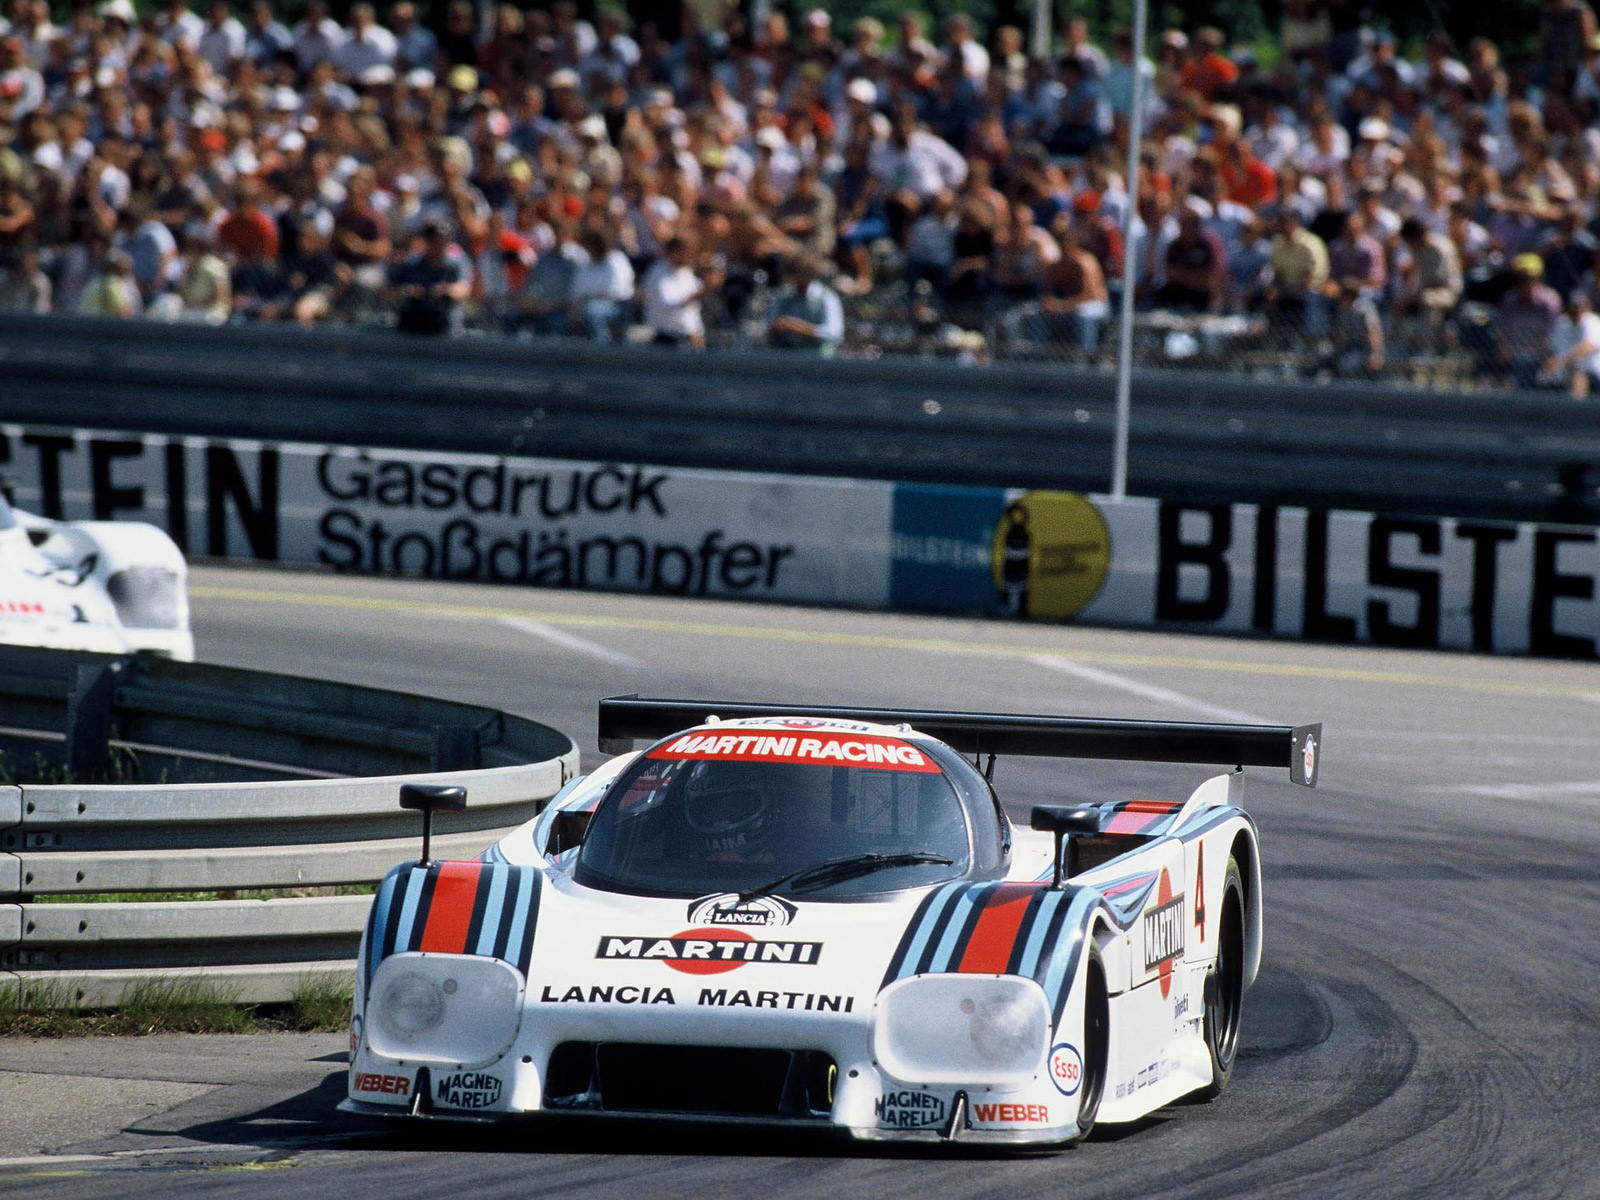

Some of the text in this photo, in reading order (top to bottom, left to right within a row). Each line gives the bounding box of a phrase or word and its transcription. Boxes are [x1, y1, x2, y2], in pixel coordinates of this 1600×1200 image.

[0, 433, 279, 560] TEIN
[317, 447, 669, 519] Gasdruck
[319, 508, 796, 597] Stoßdämpfer
[1155, 501, 1598, 660] BILSTE
[666, 735, 925, 766] MARTINI RACING
[1194, 839, 1206, 944] 4
[714, 912, 766, 924] LANCIA
[1146, 901, 1184, 965] MARTINI
[605, 938, 813, 963] MARTINI
[541, 985, 855, 1013] LANCIA MARTINI
[354, 1072, 411, 1096] WEBER
[438, 1072, 502, 1095] MAGNETI
[875, 1091, 944, 1113] MAGNETI
[875, 1105, 944, 1127] MARELLI
[974, 1103, 1049, 1124] WEBER
